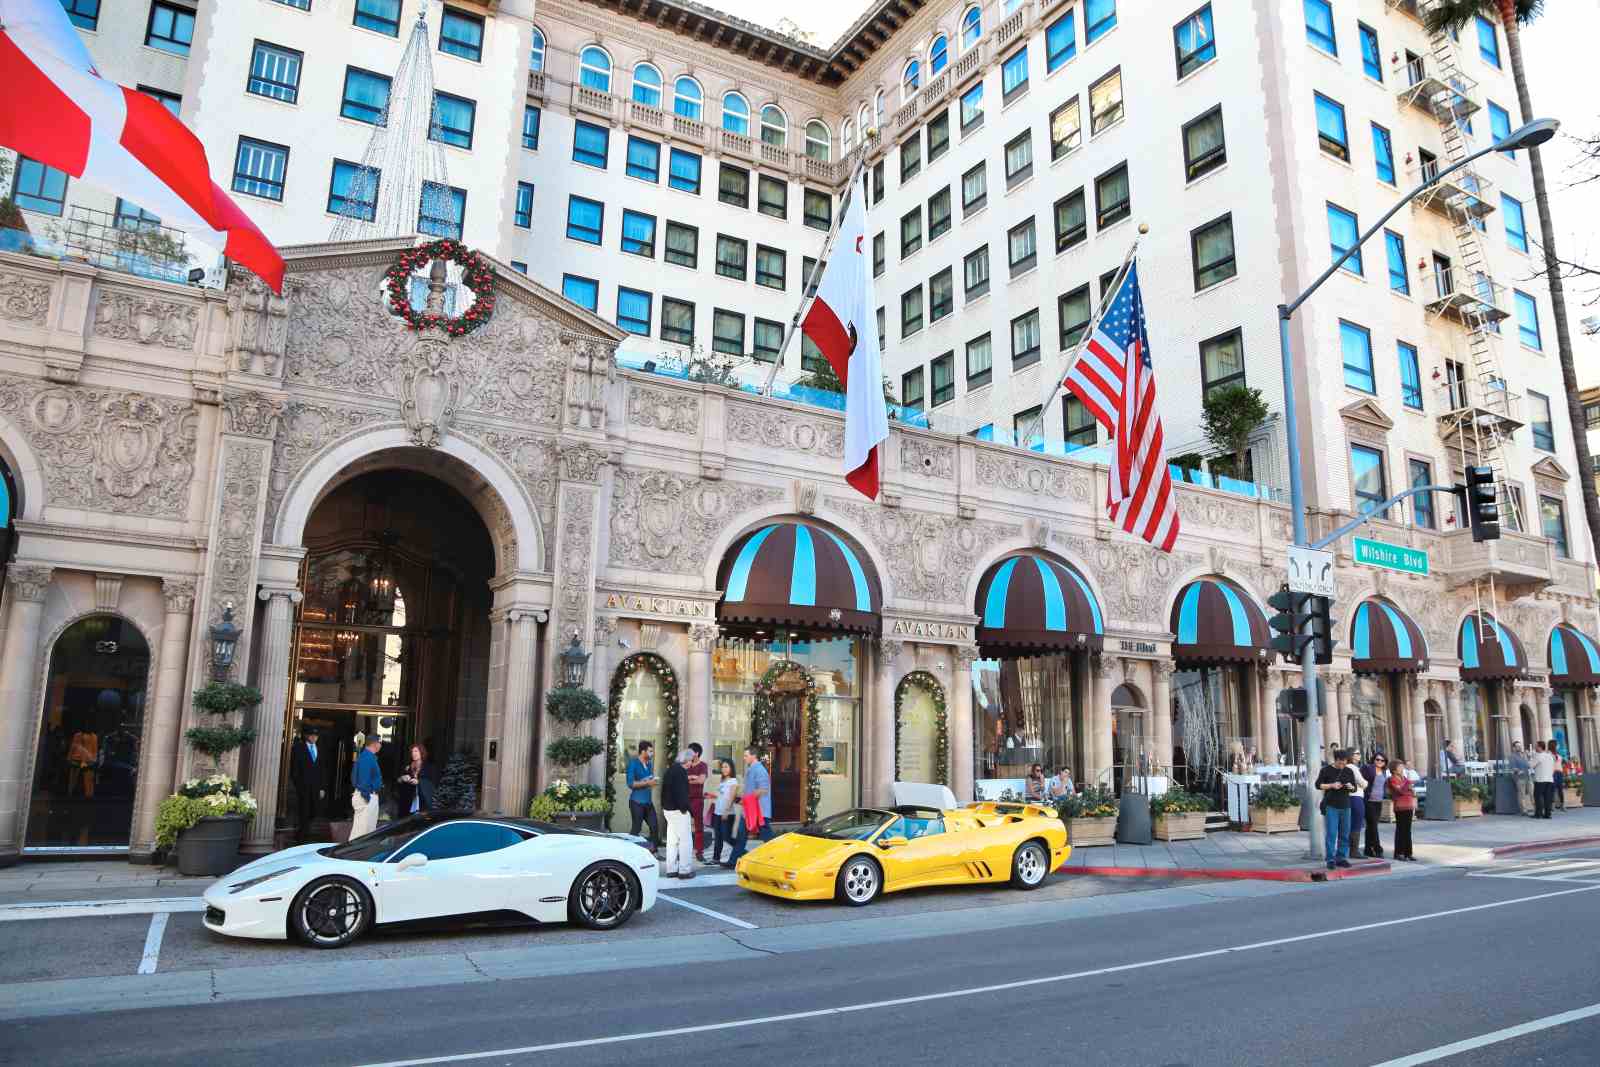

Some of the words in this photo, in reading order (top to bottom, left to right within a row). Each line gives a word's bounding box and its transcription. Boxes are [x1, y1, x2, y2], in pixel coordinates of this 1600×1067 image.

[1361, 544, 1397, 564] Wilshire
[1403, 552, 1423, 569] Blvd
[607, 592, 704, 616] AVAKIAN
[893, 620, 969, 639] AVAKIAN
